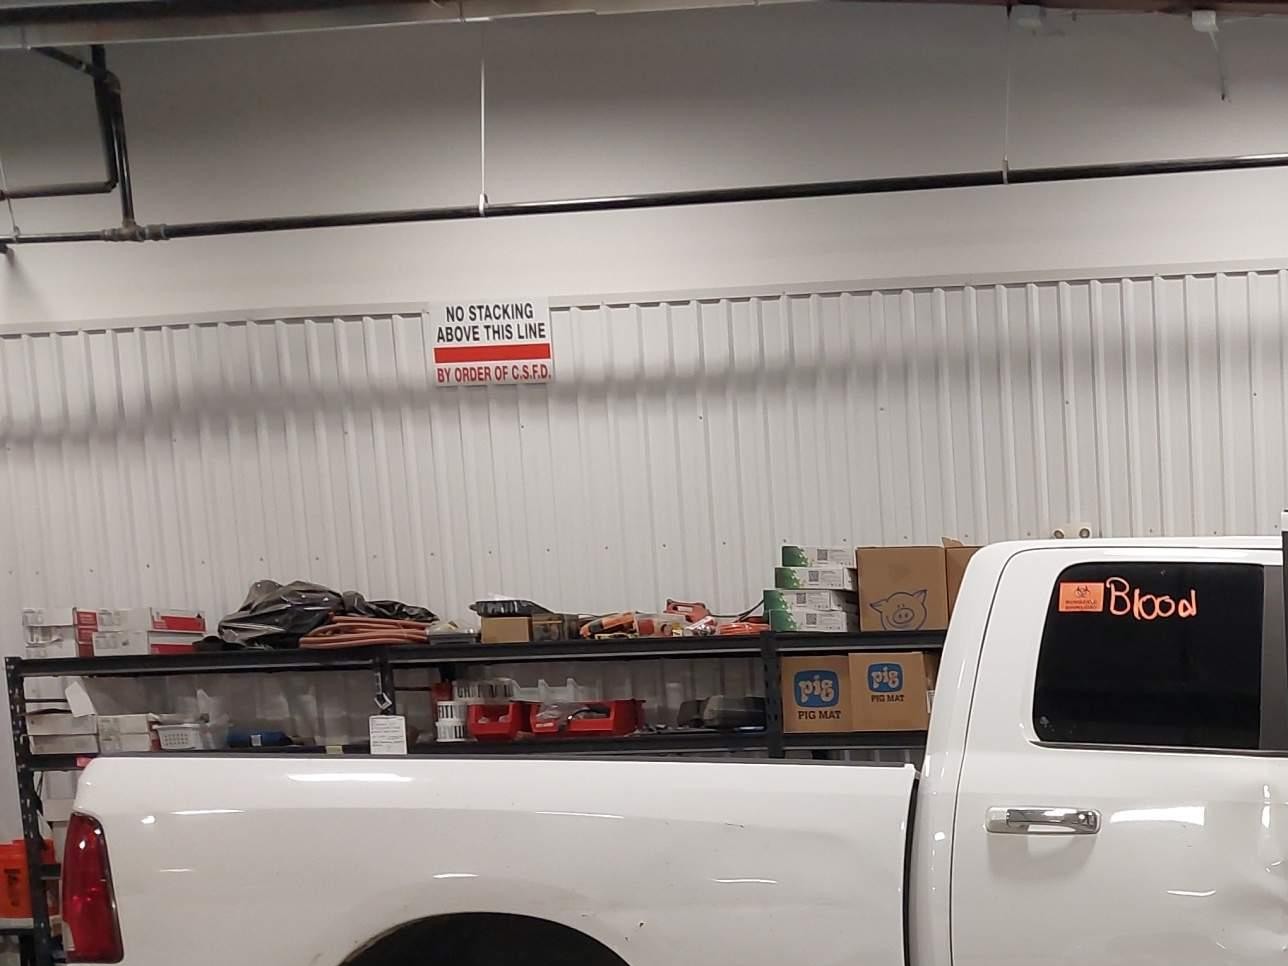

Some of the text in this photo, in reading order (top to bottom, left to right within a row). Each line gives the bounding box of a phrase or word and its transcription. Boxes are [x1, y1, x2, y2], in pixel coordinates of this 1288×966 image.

[446, 303, 533, 322] NO STACKING
[437, 322, 546, 342] ABOVE THIS LINE
[437, 364, 551, 383] BY ORDER OF C.S.F.D.
[1106, 577, 1197, 620] Blood
[871, 666, 899, 688] pig
[799, 675, 834, 702] pig
[887, 694, 904, 702] MAT
[798, 710, 841, 720] PIG MAT
